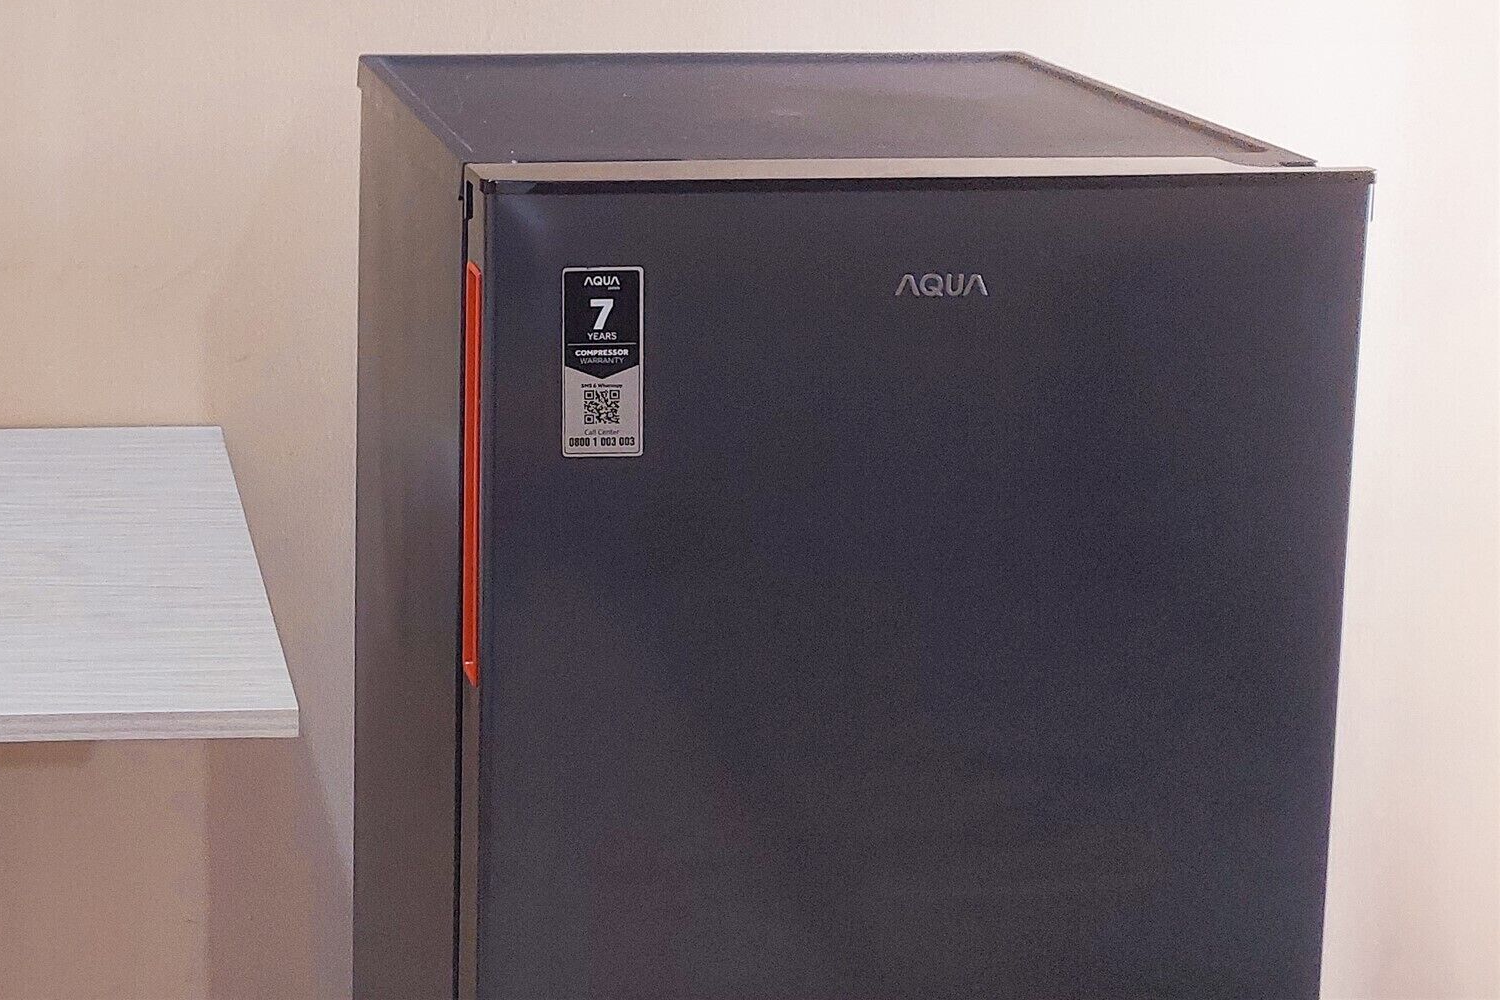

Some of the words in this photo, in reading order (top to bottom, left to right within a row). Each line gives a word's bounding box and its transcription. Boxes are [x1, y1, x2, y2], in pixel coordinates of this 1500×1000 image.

[583, 275, 620, 286] AQUA
[894, 273, 989, 297] AQUA
[590, 299, 614, 330] 7
[587, 332, 617, 341] YEARS
[575, 349, 629, 357] COMPRESSOR
[569, 438, 590, 447] 0800
[593, 438, 597, 447] 1
[601, 437, 616, 446] 003
[619, 437, 635, 446] 003
